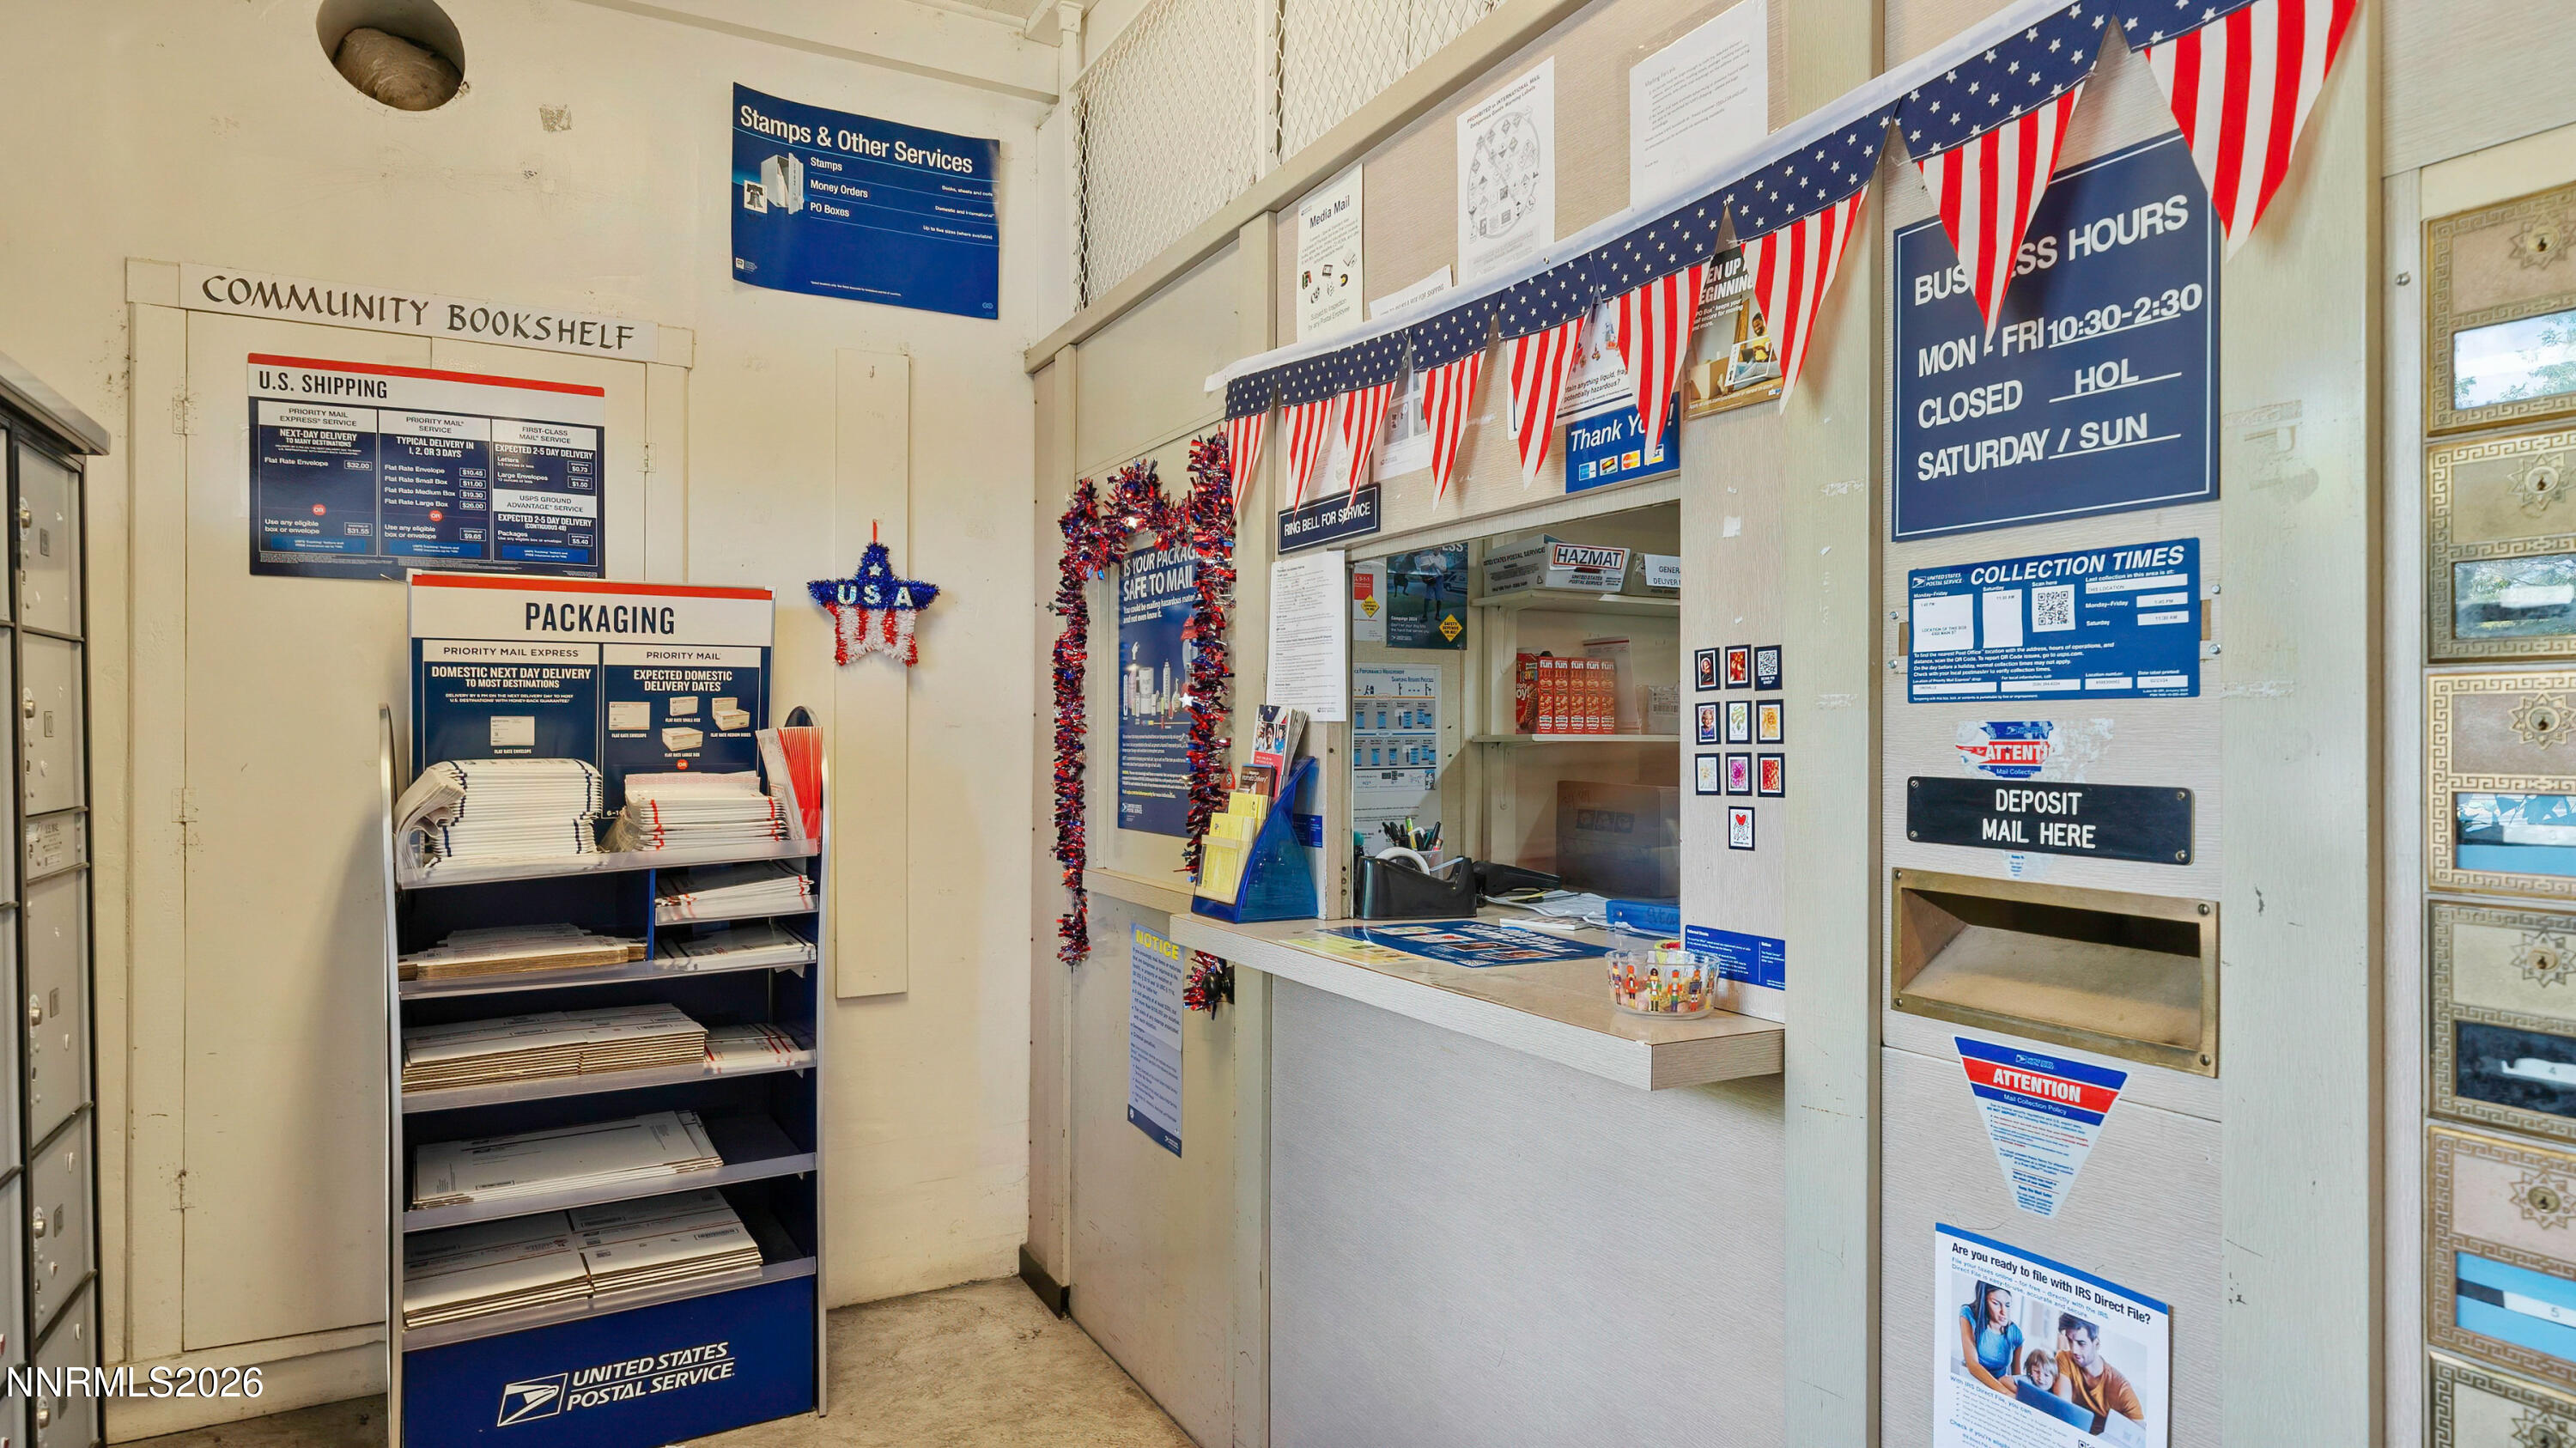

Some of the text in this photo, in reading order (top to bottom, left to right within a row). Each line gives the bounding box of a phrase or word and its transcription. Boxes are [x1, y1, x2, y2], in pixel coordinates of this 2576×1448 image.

[740, 105, 974, 173] Stamps & Other Services
[810, 156, 842, 172] Stamps
[810, 179, 868, 198] Money Orders
[810, 202, 850, 217] PO Boxes
[1309, 194, 1351, 229] Media Mail
[1915, 193, 2189, 307] BUSSS HOURS
[1705, 257, 1742, 284] EN UP
[1699, 273, 1753, 307] EGINNIN
[202, 275, 635, 350] COMMUNITY BOOKSHELF
[1918, 334, 1977, 378] MON
[2002, 316, 2044, 357] FRI
[2046, 283, 2203, 341] 10:30-2:30
[259, 370, 387, 399] U.S. SHIPPING
[1564, 367, 1628, 393] tain anything liquid, fra
[1564, 378, 1621, 404] potentially hazardous?
[1917, 357, 2140, 429] CLOSED HOL
[289, 407, 349, 418] PRIORITY MAIL
[322, 418, 357, 427] SERVICE
[405, 417, 442, 426] PRIORITY
[1570, 402, 1675, 452] Thank Yo!
[280, 429, 357, 442] NEXT-DAY DELIVERY
[418, 425, 453, 435] SERVICE
[522, 426, 568, 436] FIRST-CLASS
[396, 435, 475, 450] TYPICAL DELIVERY IN
[540, 435, 571, 444] SERVICE
[1917, 428, 2050, 482] SATURDAY
[2079, 411, 2148, 450] SUN
[495, 444, 593, 460] EXPECTED 2-5 DAY DELIVERY
[297, 459, 329, 468] Envelope
[519, 495, 539, 503] USPS
[553, 505, 584, 514] SERVICE
[497, 514, 592, 527] EXPECTED 2-5 DAY DELIVERY
[1284, 502, 1371, 537] RING BELL FOR SERVICE
[1123, 542, 1201, 577] IS YOUR PACKAG
[1556, 547, 1622, 567] HAZMAT
[1658, 565, 1680, 574] GENER
[1971, 545, 2185, 586] COLLECTION TIMES
[1123, 564, 1194, 602] SAFE TO MAIL
[1653, 577, 1680, 586] DELIVER
[1913, 591, 1948, 599] Monday-Friday
[2085, 600, 2129, 609] Monday-Friday
[525, 601, 675, 635] PACKAGING
[443, 647, 579, 657] PRIORITY MAIL EXPRESS
[646, 651, 720, 660] PRIORITY MAIL
[1540, 660, 1552, 668] fun
[1555, 660, 1568, 669] fun
[1571, 660, 1584, 669] fun
[1586, 660, 1600, 670] fun
[1601, 661, 1614, 670] fun
[431, 666, 592, 680] DOMESTIC NEXT DAY DELIVERY
[634, 669, 732, 682] EXPECTED DOMESTIC
[465, 678, 560, 689] TO MOST DESTINATIONS
[644, 680, 721, 692] DELIVERY DATES
[1984, 744, 2049, 761] ATTENT
[1995, 788, 2083, 816] DEPOSIT
[1982, 818, 2097, 849] MAIL HERE
[1136, 928, 1180, 961] NOTICE
[1992, 1068, 2081, 1104] ATTENTION
[2003, 1093, 2067, 1116] Mail Collection Policy
[1951, 1242, 2152, 1325] Are you ready to file with IRS Direct File?
[2550, 1306, 2560, 1317] 5
[572, 1342, 729, 1387] UNITED STATES
[566, 1380, 647, 1412] POSTAL
